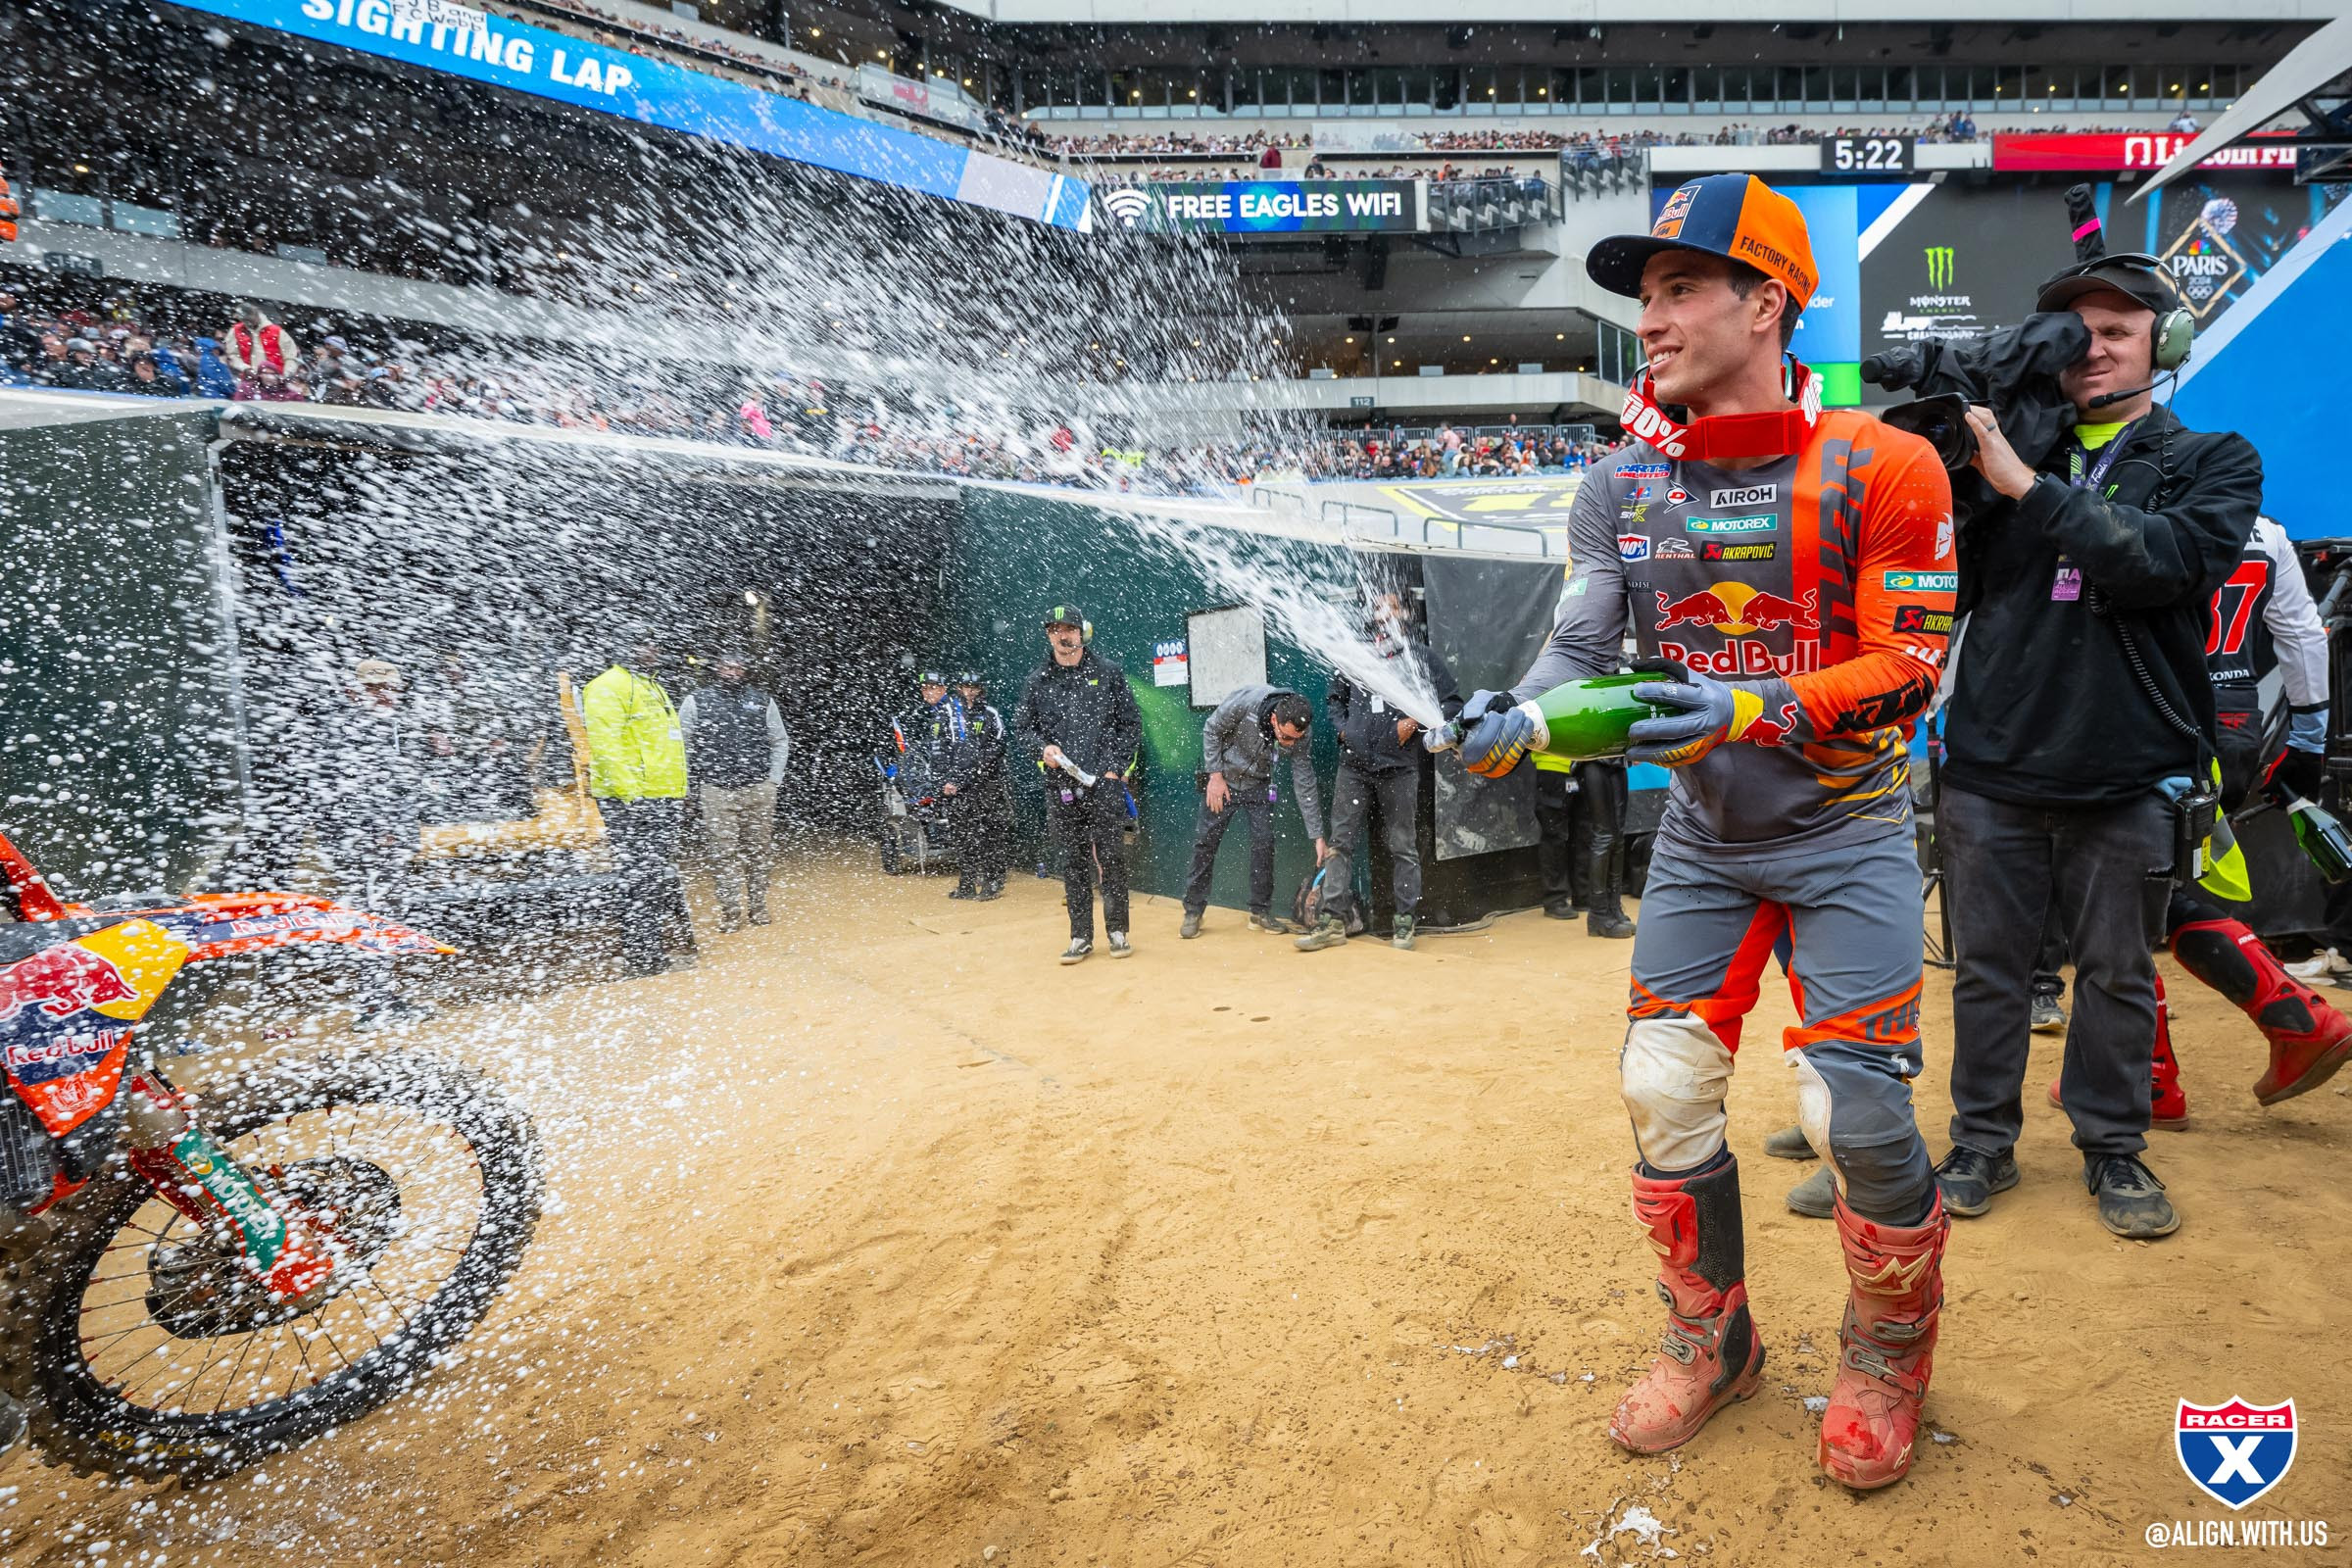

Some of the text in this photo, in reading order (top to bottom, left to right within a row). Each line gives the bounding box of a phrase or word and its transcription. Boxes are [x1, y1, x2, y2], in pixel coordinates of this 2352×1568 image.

[301, 0, 633, 96] SIGHTING LAP
[1835, 139, 1903, 170] 5:22
[1168, 192, 1402, 219] FREE EAGLES WIFI
[1740, 235, 1811, 296] FACTORY RACING
[2173, 255, 2229, 276] PARIS
[1909, 295, 1971, 308] MONSTER
[1617, 463, 1672, 472] PARTS
[1715, 486, 1772, 506] AIROH
[1711, 516, 1771, 531] MOTOREX
[1658, 639, 1821, 677] Red Bull
